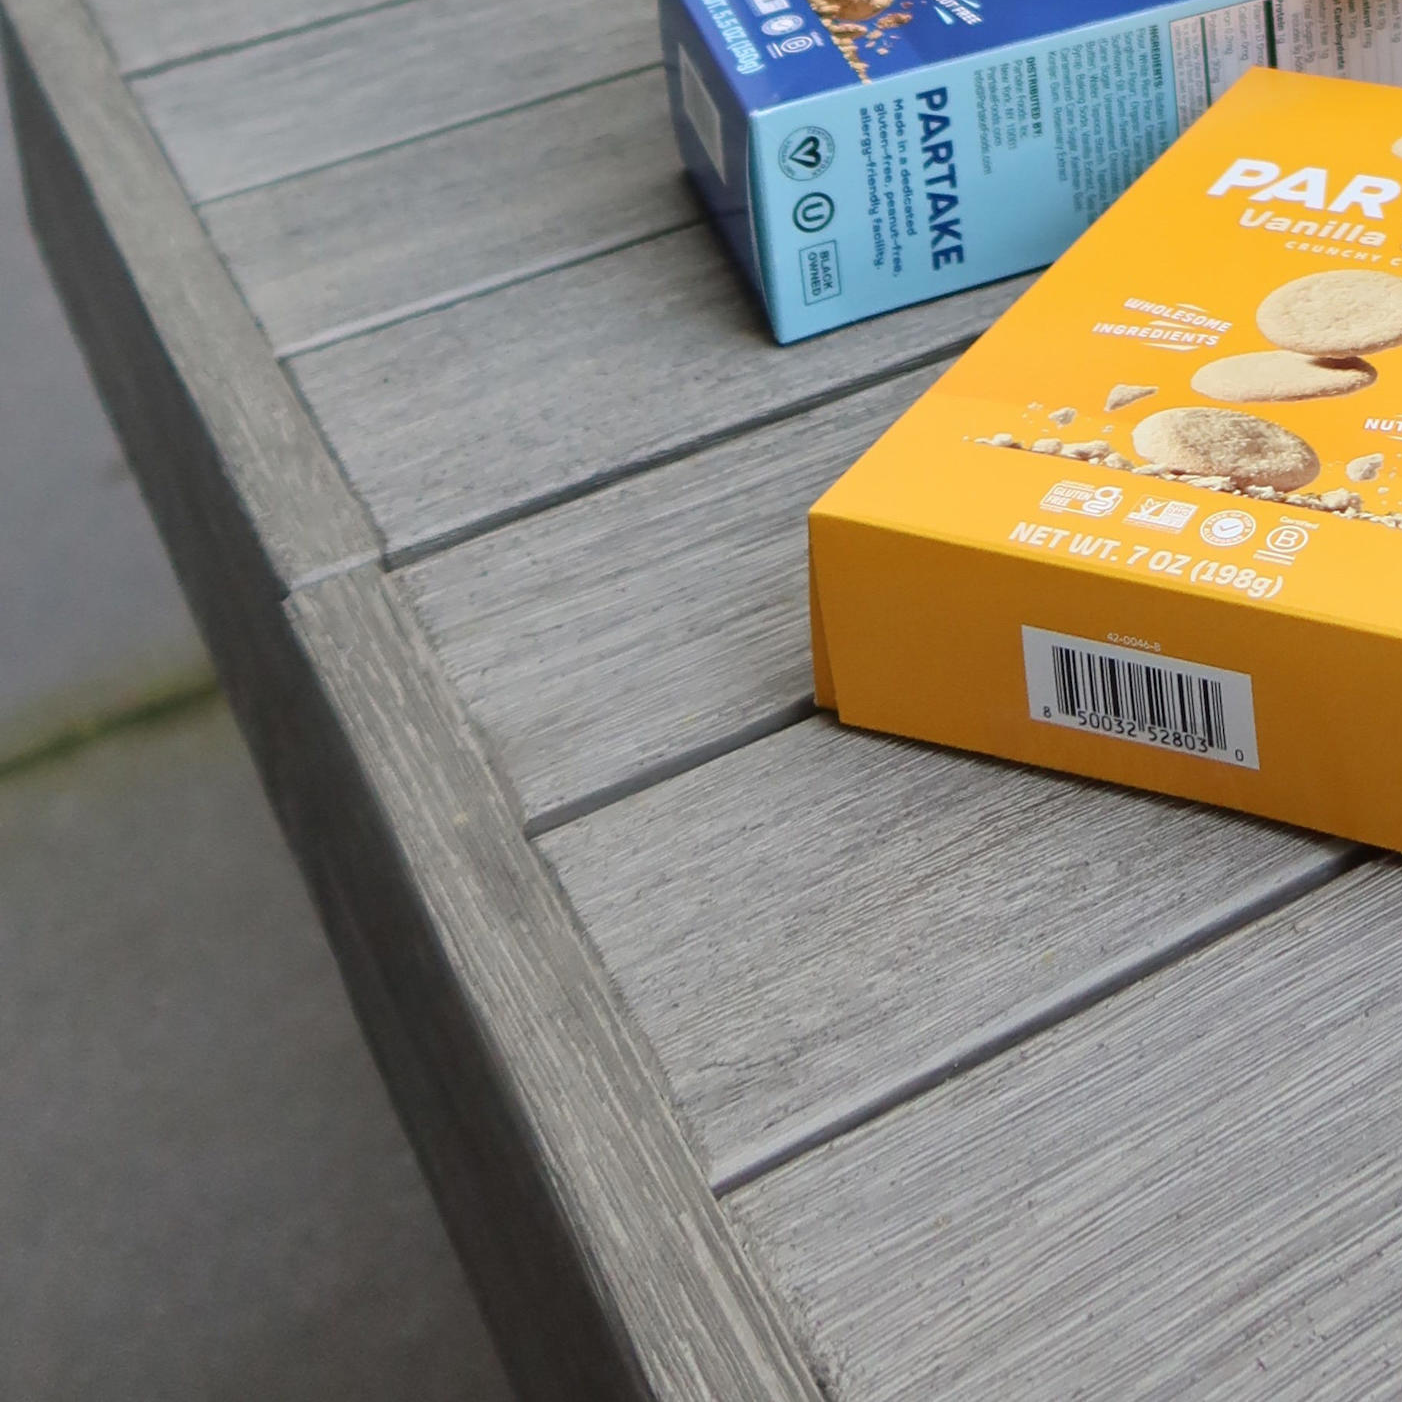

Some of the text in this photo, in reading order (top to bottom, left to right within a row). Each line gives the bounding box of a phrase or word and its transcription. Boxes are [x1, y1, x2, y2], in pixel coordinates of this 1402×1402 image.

[713, 10, 738, 29] 5.5
[952, 6, 982, 24] FREE
[722, 26, 747, 43] OZ
[728, 41, 764, 74] (150g)
[1027, 57, 1041, 119] DISTRIBUTED
[894, 99, 906, 136] Made
[897, 140, 907, 153] in
[860, 108, 885, 269] allergy-friendly facility.
[918, 88, 964, 269] PARTAKE
[901, 169, 917, 236] dedicated
[885, 192, 903, 277] peanut-free,
[1238, 207, 1388, 248] Vanilla
[819, 251, 833, 289] BLACK
[1284, 240, 1383, 264] CRUNCHY
[808, 252, 821, 296] OWNED
[1123, 296, 1233, 333] WHOLESOME
[1092, 322, 1220, 347] INGREDIENTS
[1008, 521, 1285, 600] NET WT. 7 OZ (198g)
[1042, 705, 1245, 763] 8 50032 52803 0
